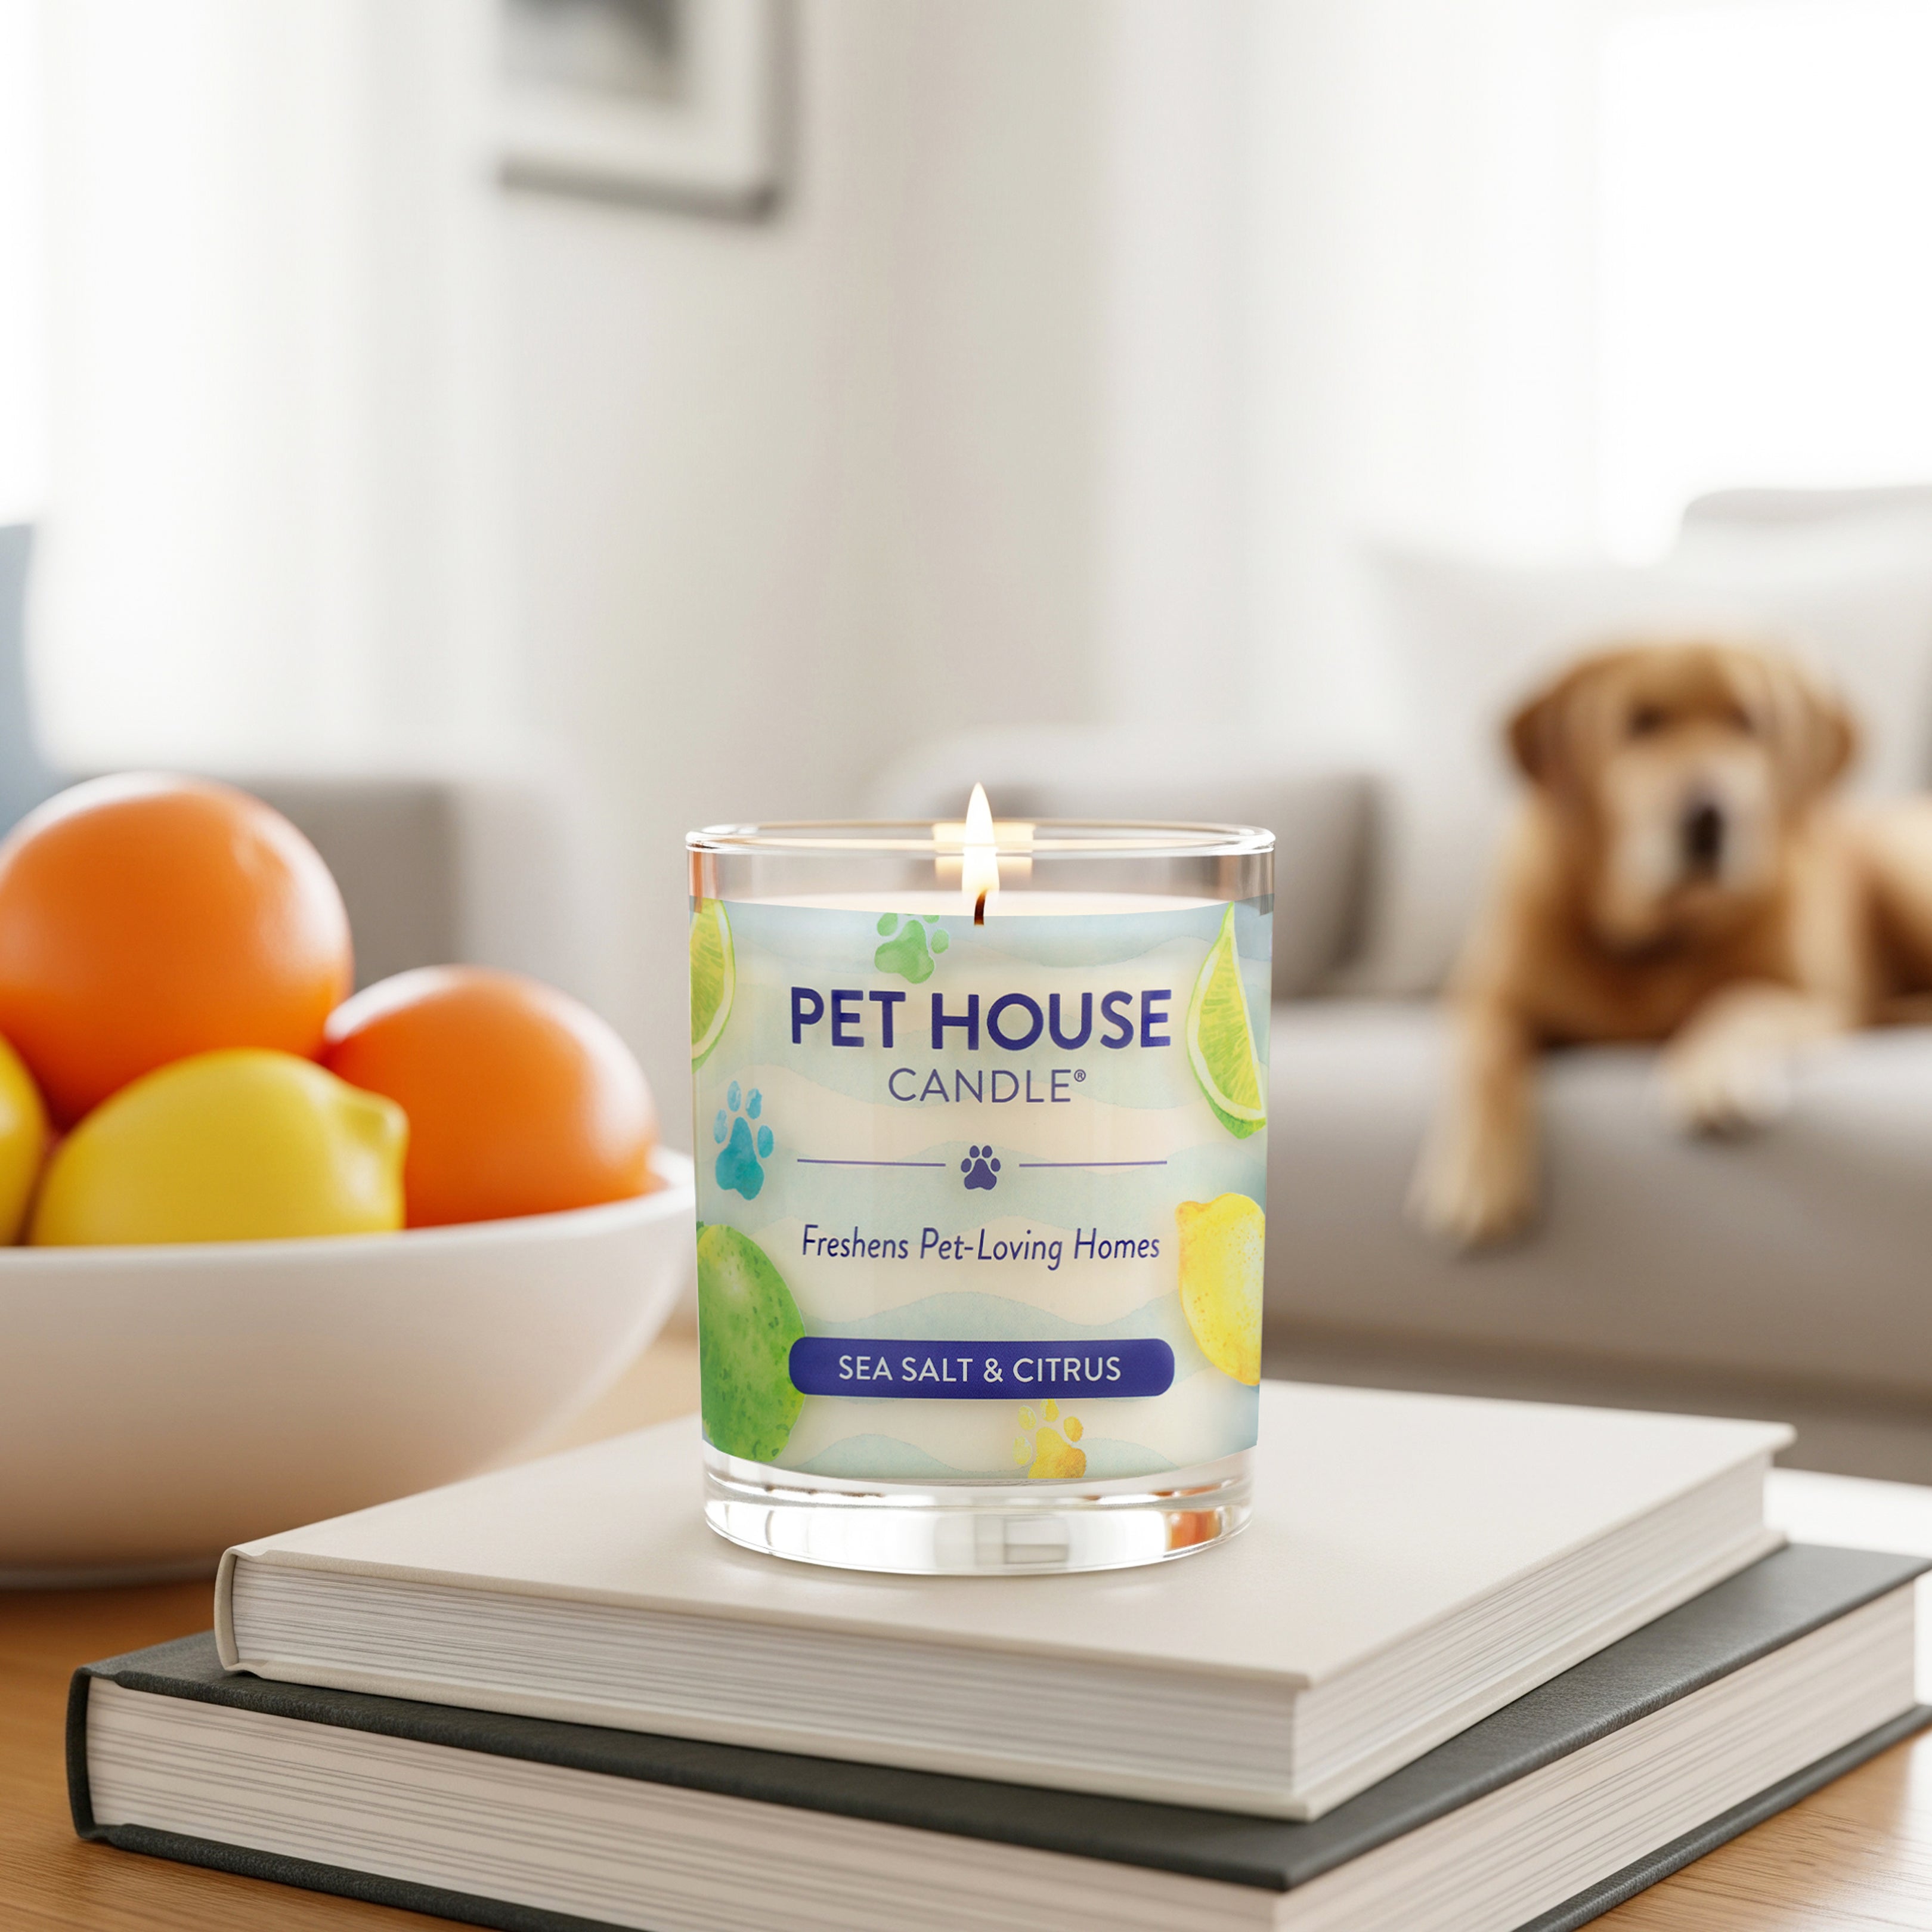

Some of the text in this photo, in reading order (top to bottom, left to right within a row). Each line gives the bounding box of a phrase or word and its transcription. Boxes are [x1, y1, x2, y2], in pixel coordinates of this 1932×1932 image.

[791, 986, 1172, 1051] PET HOUSE
[802, 1224, 1160, 1271] Freshens Pet-Loving Homes
[838, 1355, 1122, 1383] SEA SALT & CITRUS
